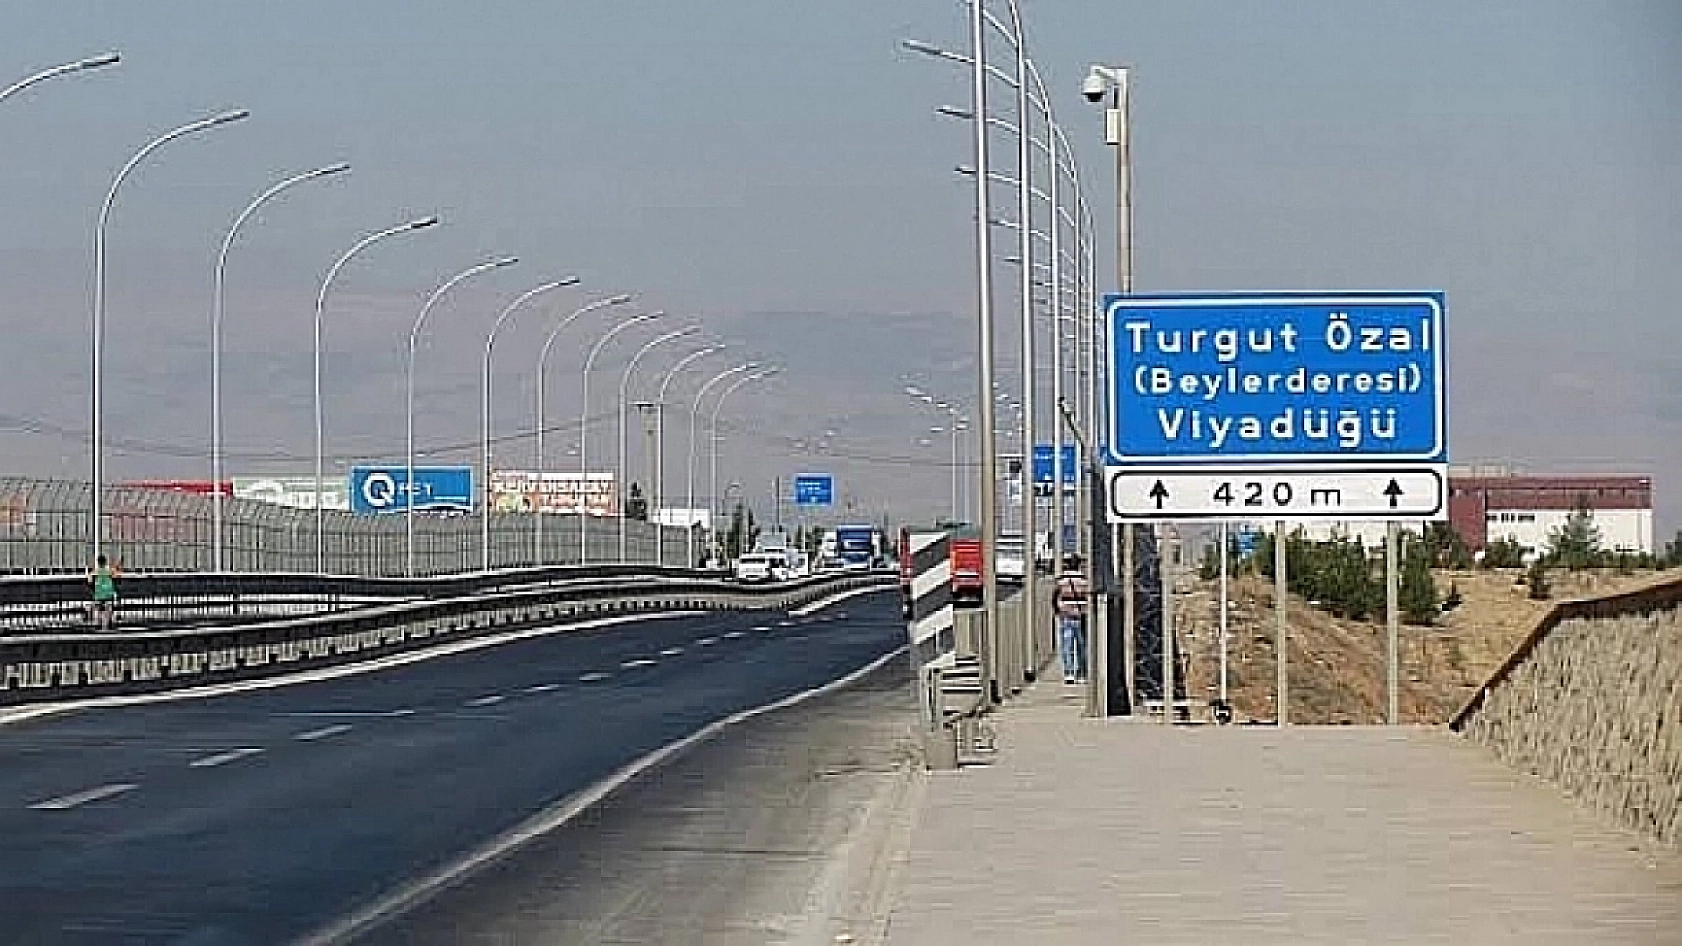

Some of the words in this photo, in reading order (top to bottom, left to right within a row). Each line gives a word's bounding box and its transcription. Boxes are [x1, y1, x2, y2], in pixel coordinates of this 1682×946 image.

[1125, 322, 1298, 362] Turgut
[1325, 312, 1430, 352] Özal
[1134, 363, 1421, 400] (Beylerderesi)
[1158, 407, 1397, 448] Viyadüğü
[1213, 482, 1293, 507] 420
[1310, 488, 1341, 507] m
